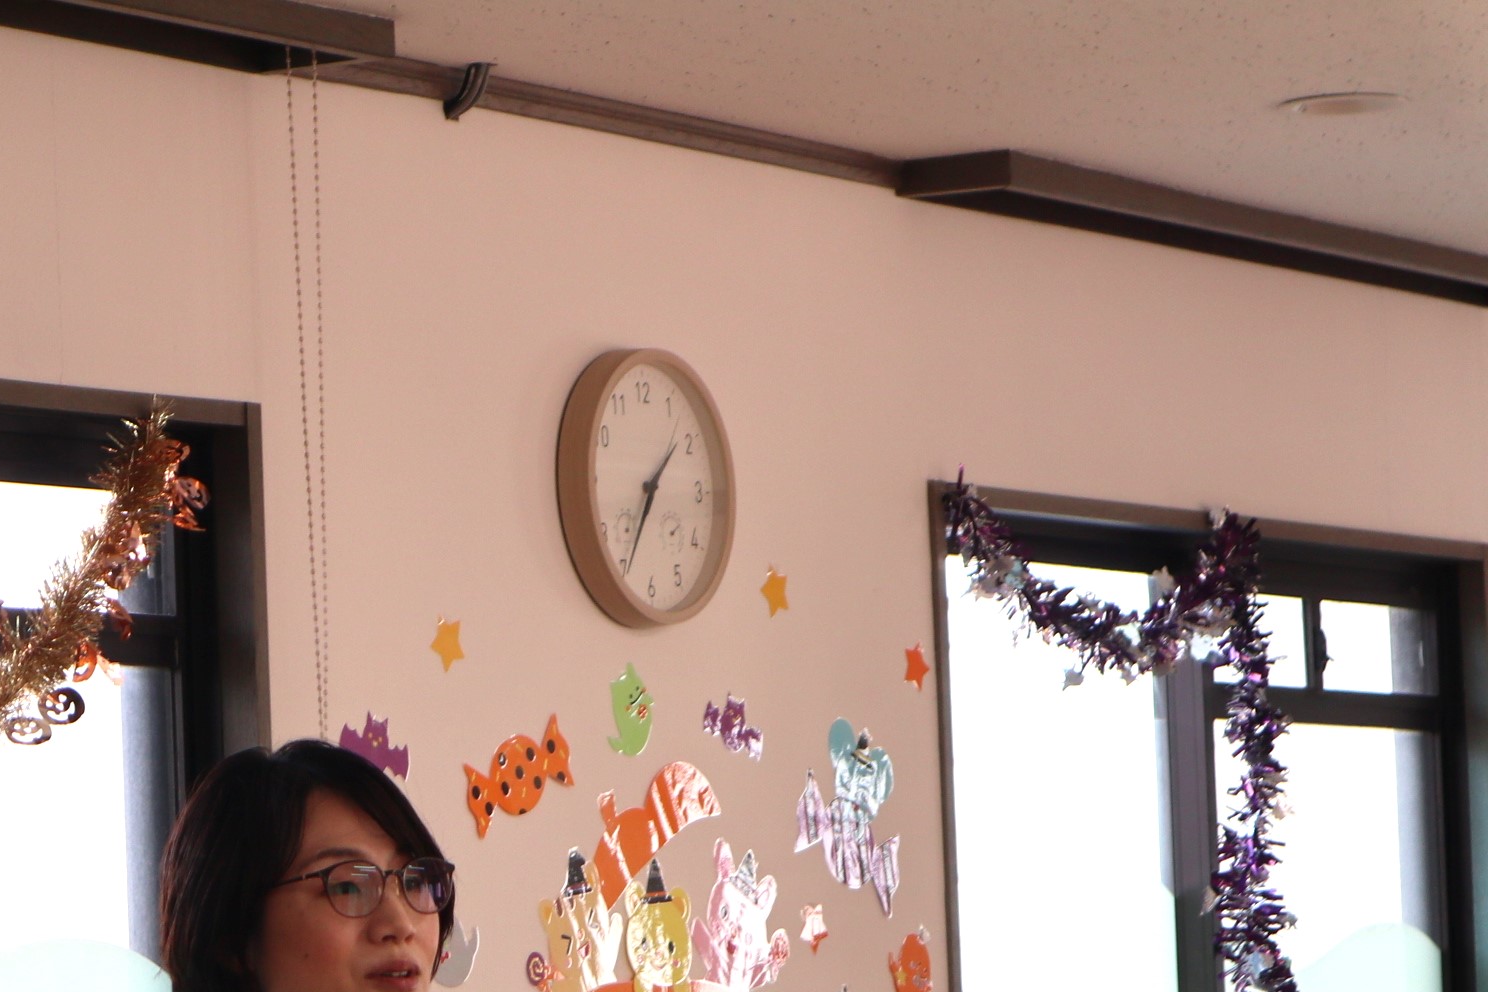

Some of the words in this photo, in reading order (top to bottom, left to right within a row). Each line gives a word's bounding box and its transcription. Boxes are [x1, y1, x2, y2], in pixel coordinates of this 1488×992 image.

[636, 381, 650, 404] 12
[612, 393, 626, 415] 11
[665, 396, 672, 418] 1
[685, 433, 693, 455] 2
[694, 480, 703, 503] 3
[690, 527, 699, 548] 4
[619, 558, 628, 578] 7
[673, 564, 682, 587] 5
[647, 575, 656, 598] 6
